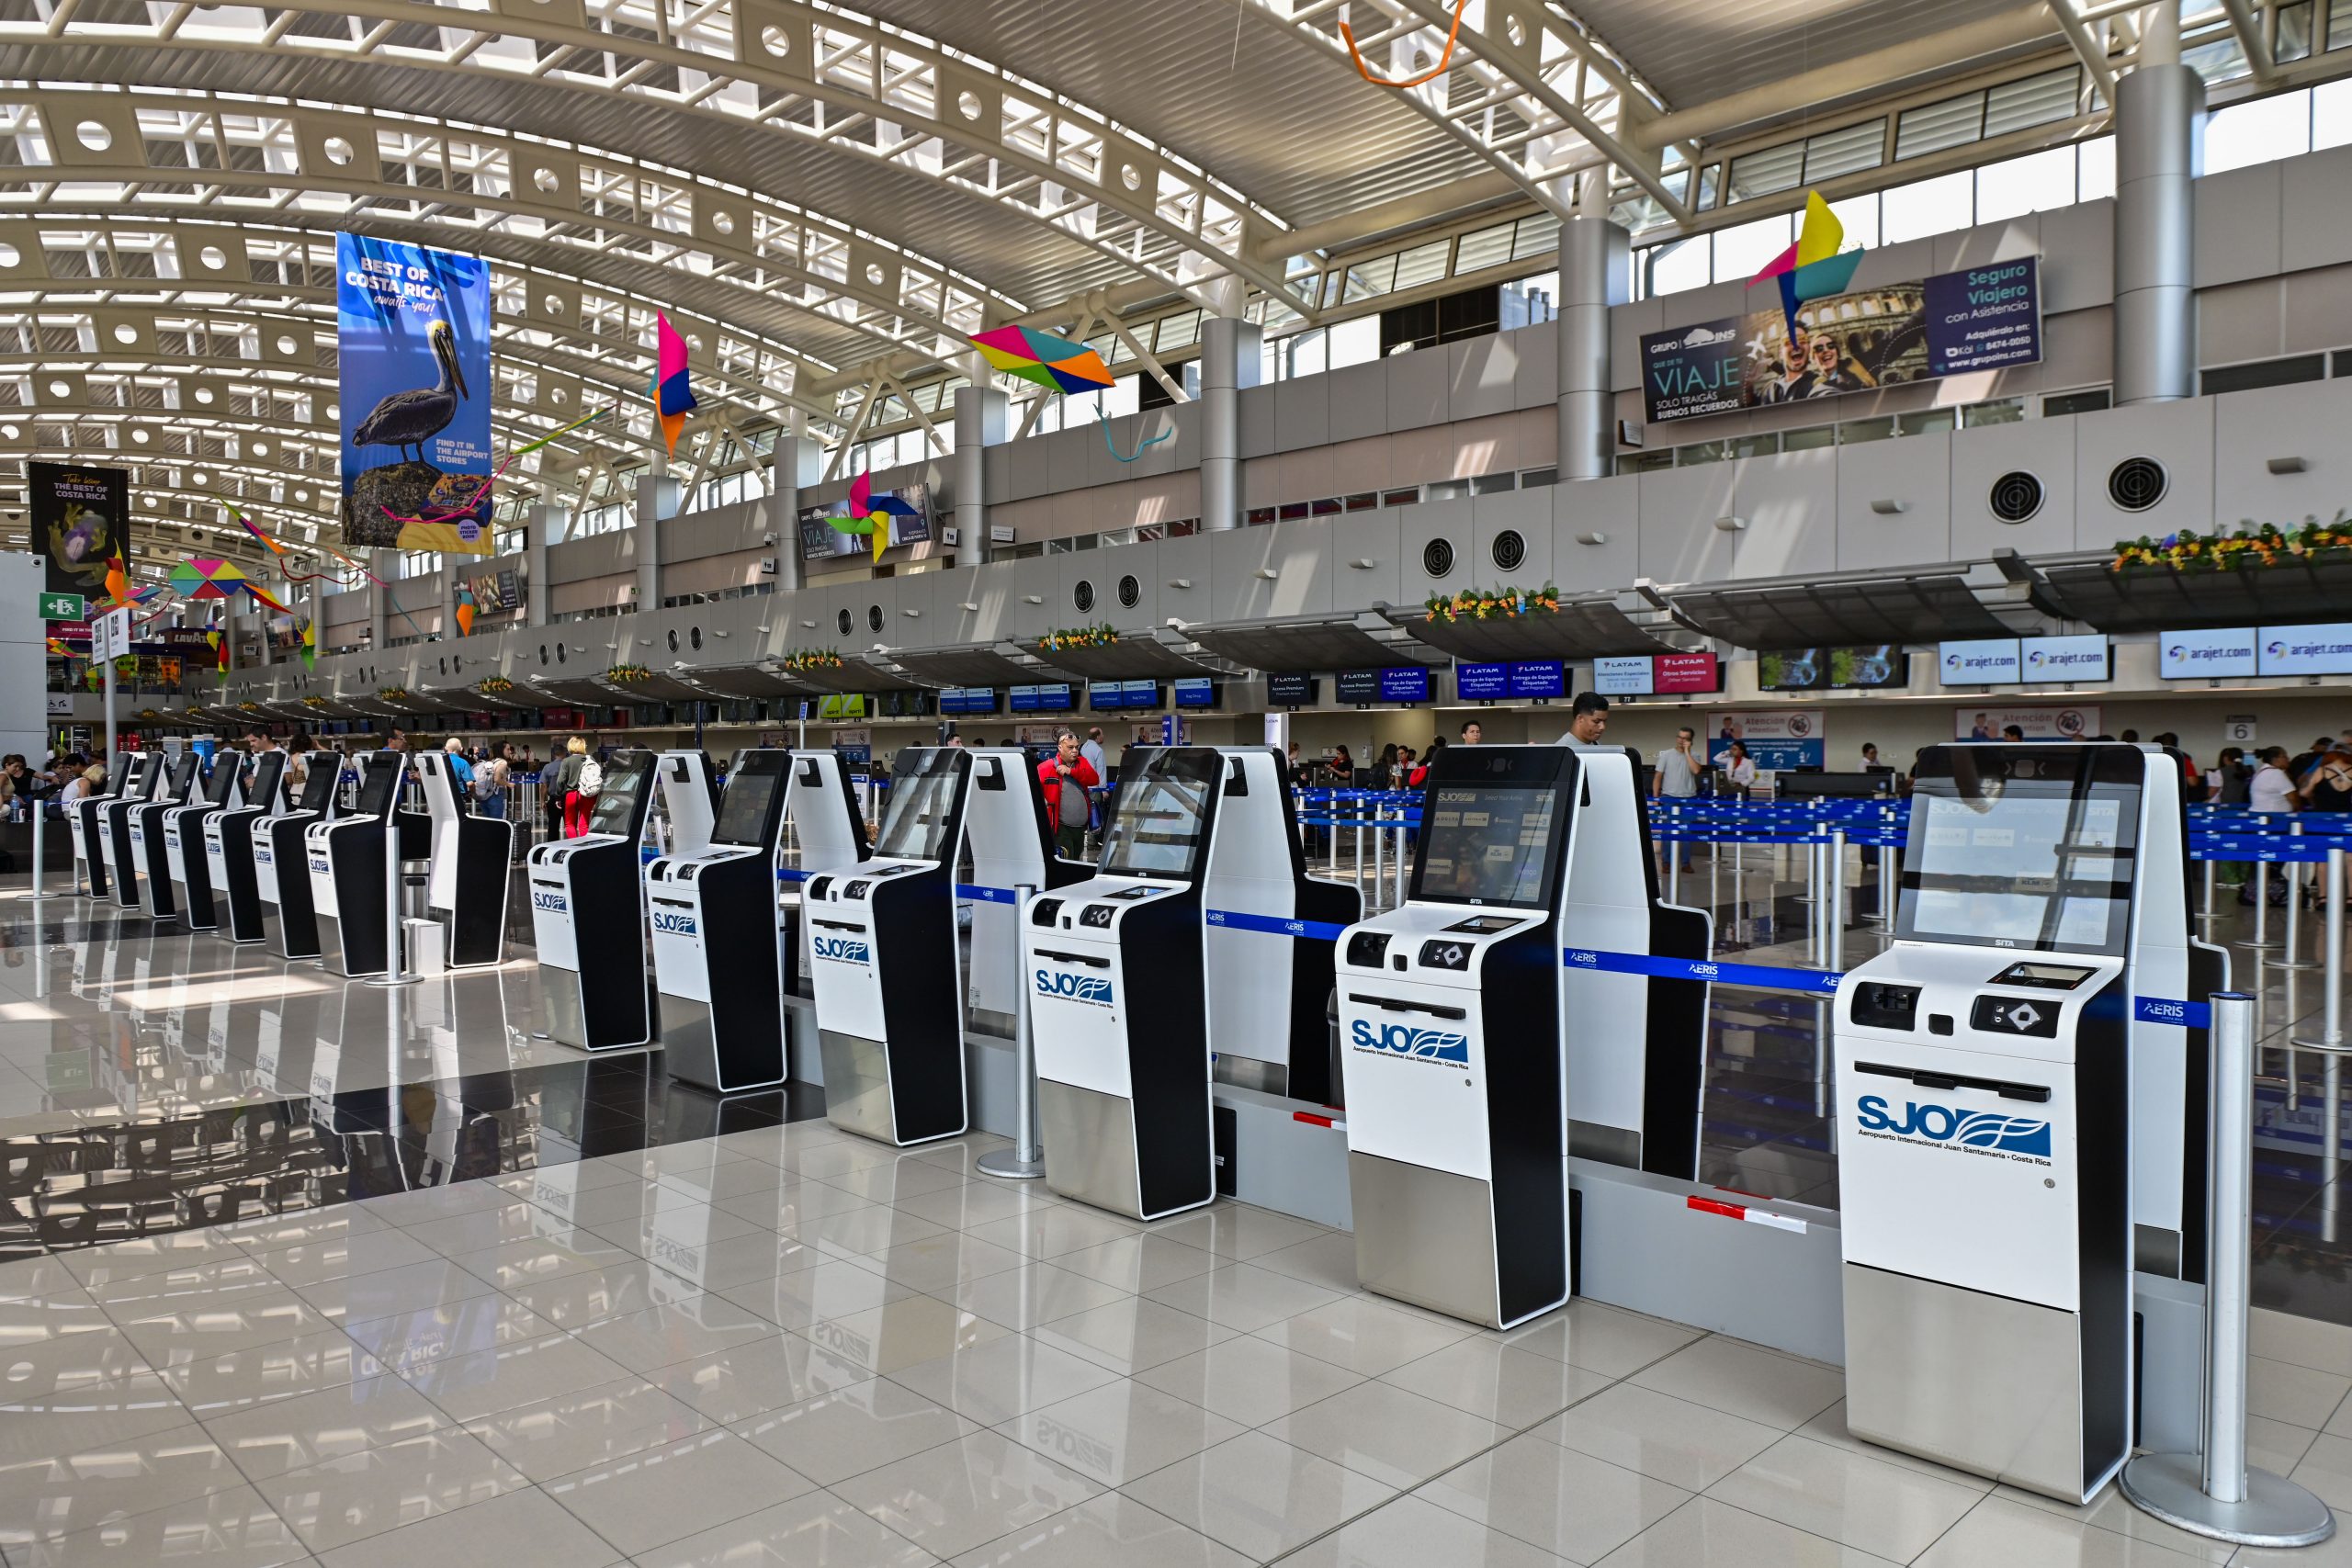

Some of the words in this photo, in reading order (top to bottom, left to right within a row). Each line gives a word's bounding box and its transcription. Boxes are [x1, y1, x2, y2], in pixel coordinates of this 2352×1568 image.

[361, 257, 402, 276] BEST
[407, 266, 429, 282] OF
[1968, 265, 2027, 286] Seguro
[345, 271, 400, 293] COSTA
[404, 282, 443, 301] RICA
[1968, 285, 2028, 305] Viajero
[374, 293, 408, 309] awaits
[412, 300, 435, 317] you!
[1945, 313, 1968, 324] con
[1971, 300, 2030, 319] Asistencia
[1650, 341, 1678, 354] GRUPO
[1714, 329, 1736, 341] INS
[1948, 349, 2031, 368] www.grupoins.com
[1654, 357, 1740, 396] VIAJE
[1657, 398, 1680, 410] SOLO
[1657, 407, 1690, 420] BUENOS
[1690, 399, 1739, 414] RECUERDOS
[436, 439, 455, 448] FIND
[457, 441, 464, 449] IT
[436, 446, 452, 456] THE
[454, 449, 489, 460] AIRPORT
[436, 456, 467, 466] STORES
[54, 482, 71, 491] THE
[74, 484, 95, 492] BEST
[56, 491, 84, 499] COSTA
[85, 492, 107, 501] RICA
[804, 526, 834, 547] VIAJE
[174, 631, 208, 644] LAVAZ
[2048, 651, 2103, 667] arajet.com
[2190, 646, 2252, 661] arajet.com
[1964, 655, 2016, 670] arajet.com
[1746, 716, 1785, 726] Atención
[2002, 713, 2053, 723] Atención
[2234, 724, 2247, 739] 6
[535, 892, 552, 908] SJO
[654, 911, 676, 931] SJO
[1285, 921, 1304, 931] AERIS
[814, 936, 843, 958] SJO
[1995, 939, 2015, 947] SITA
[1570, 952, 1597, 964] AERIS
[1689, 964, 1718, 976] AERIS
[1036, 969, 1075, 997] SJO
[2143, 1002, 2184, 1018] AERIS
[1352, 1019, 1412, 1053] SJO
[1352, 1045, 1376, 1055] Aeropuerto
[1377, 1050, 1404, 1060] Internacional
[1858, 1095, 1957, 1141] SJO
[1858, 1129, 1896, 1142] Aeropuerto
[1897, 1134, 1943, 1149] Internacional
[1943, 1142, 1962, 1152] Juan
[2011, 1154, 2033, 1165] Costa
[2035, 1157, 2052, 1168] Rica
